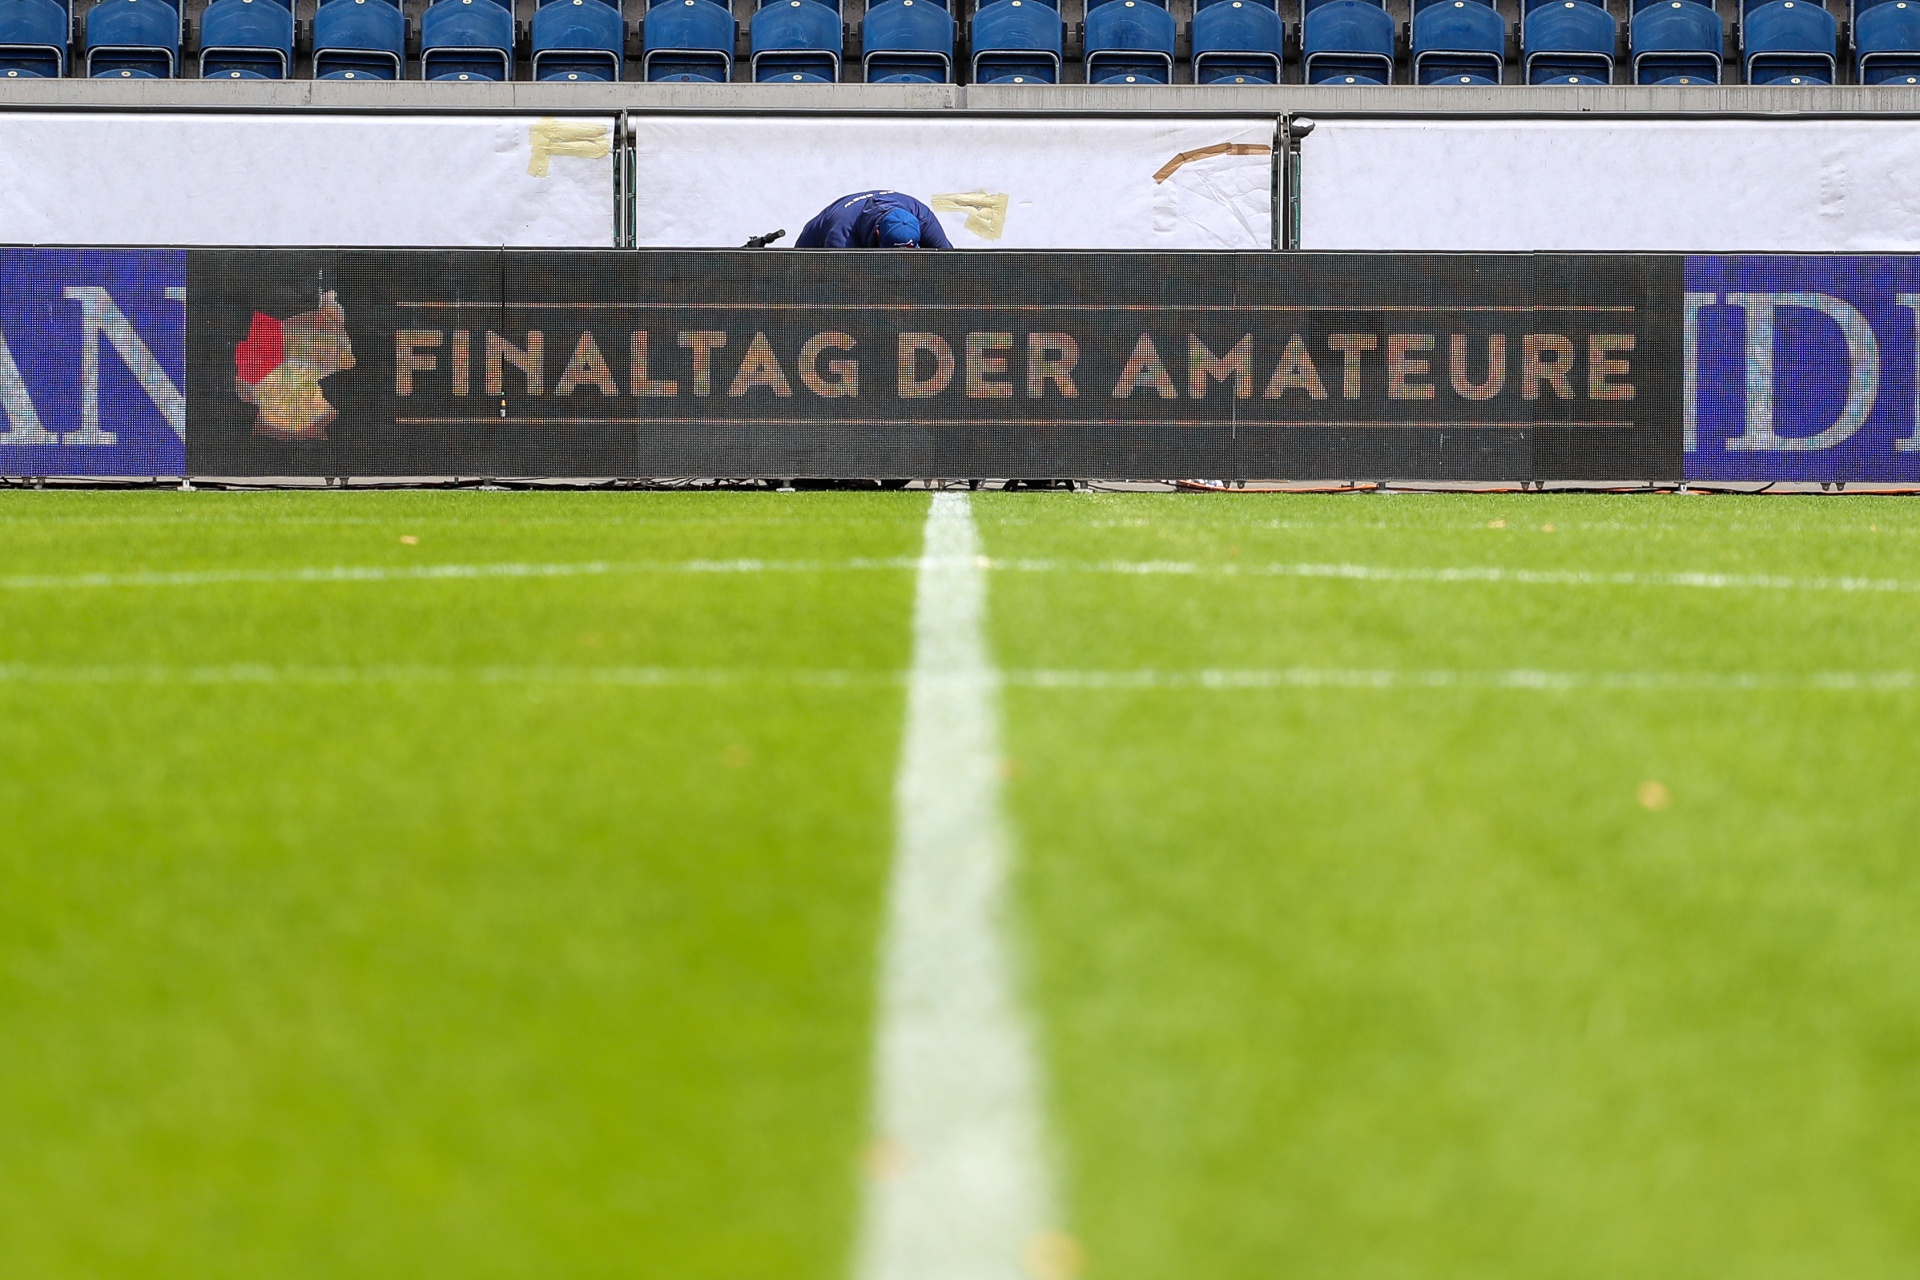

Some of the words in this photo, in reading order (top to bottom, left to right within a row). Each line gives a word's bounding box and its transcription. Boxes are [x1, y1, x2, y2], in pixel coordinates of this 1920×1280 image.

[395, 329, 859, 399] FINALTAG
[897, 331, 1081, 400] DER
[1112, 331, 1636, 401] AMATEURE
